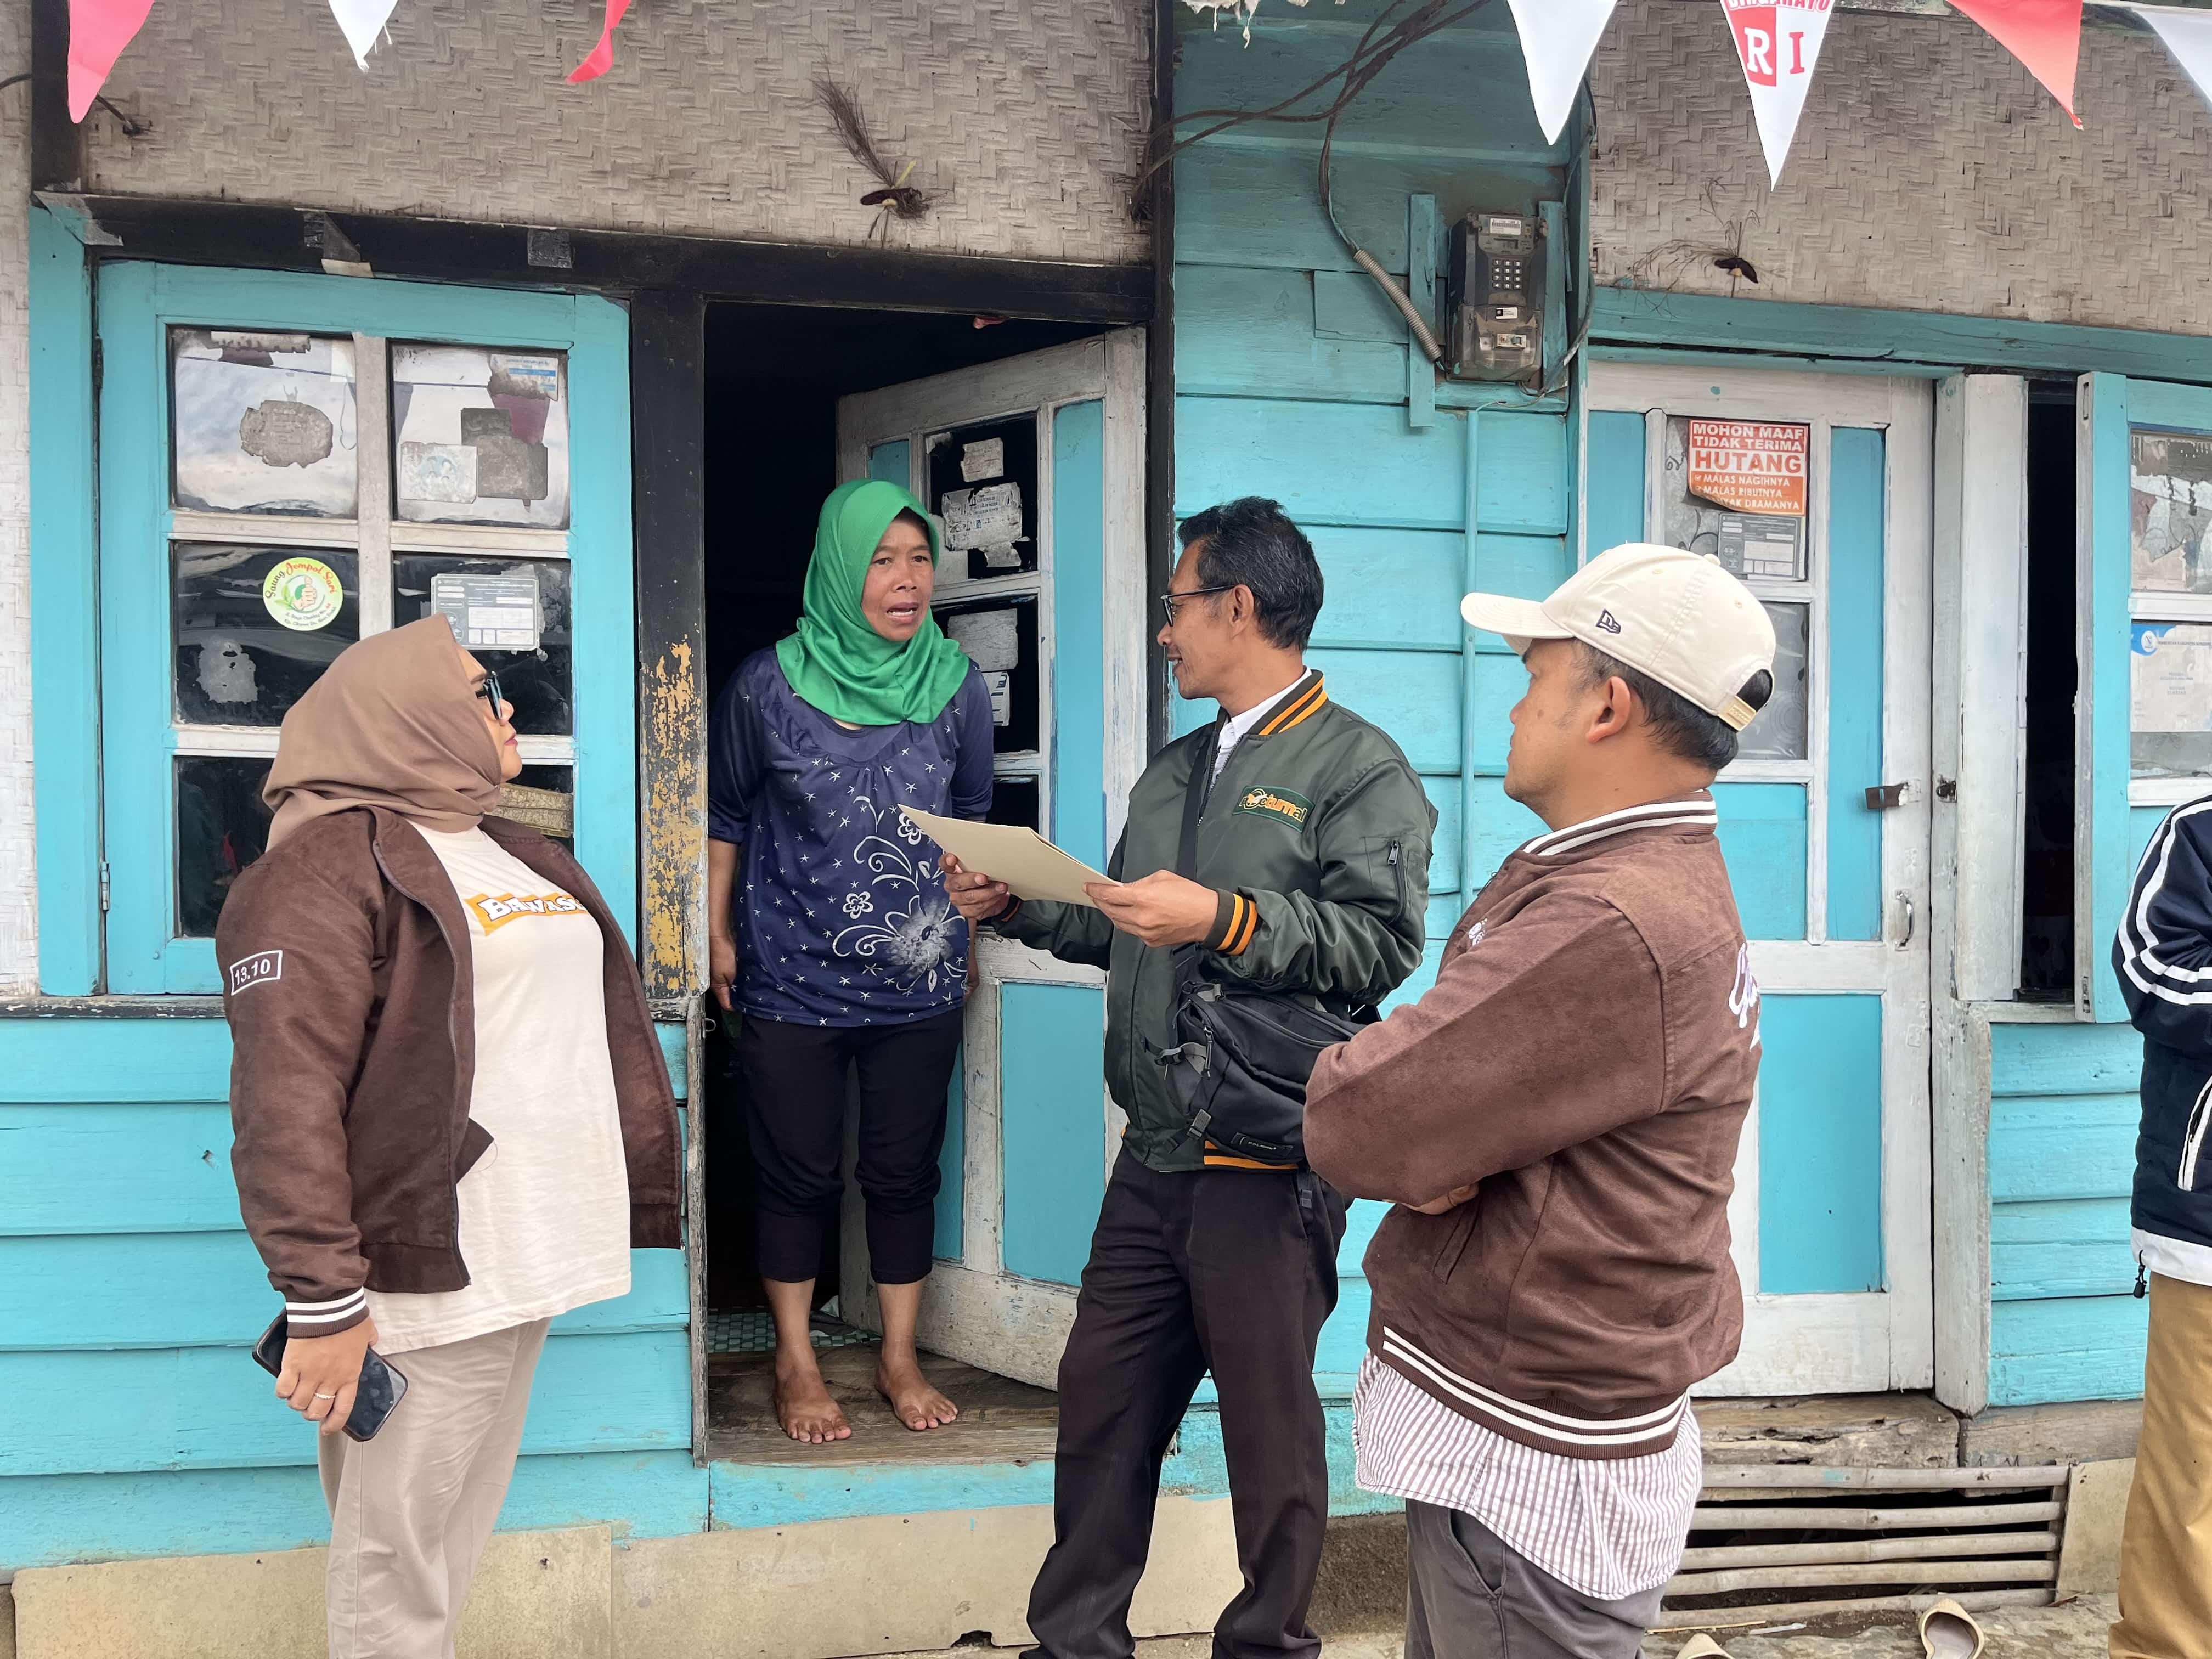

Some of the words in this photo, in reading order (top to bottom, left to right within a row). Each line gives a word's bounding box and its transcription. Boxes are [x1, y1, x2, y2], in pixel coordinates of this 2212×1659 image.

[1694, 423, 1754, 437] MOHON
[1759, 426, 1804, 439] MAAF
[1694, 436, 1740, 449] TIDAK
[1746, 439, 1802, 452] TERIMA
[1695, 450, 1802, 473] HUTANG
[1703, 474, 1736, 484] MALAS
[1738, 476, 1790, 487] NAGIHNYA
[1703, 486, 1736, 495] MALAS
[1738, 487, 1782, 498] RIBUTNYA
[1745, 499, 1799, 510] DRAMANYA
[265, 571, 285, 599] Saung
[285, 562, 324, 575] Jempol
[323, 571, 337, 594] Sari
[477, 896, 588, 922] BAWASL
[235, 958, 271, 985] 13.10
